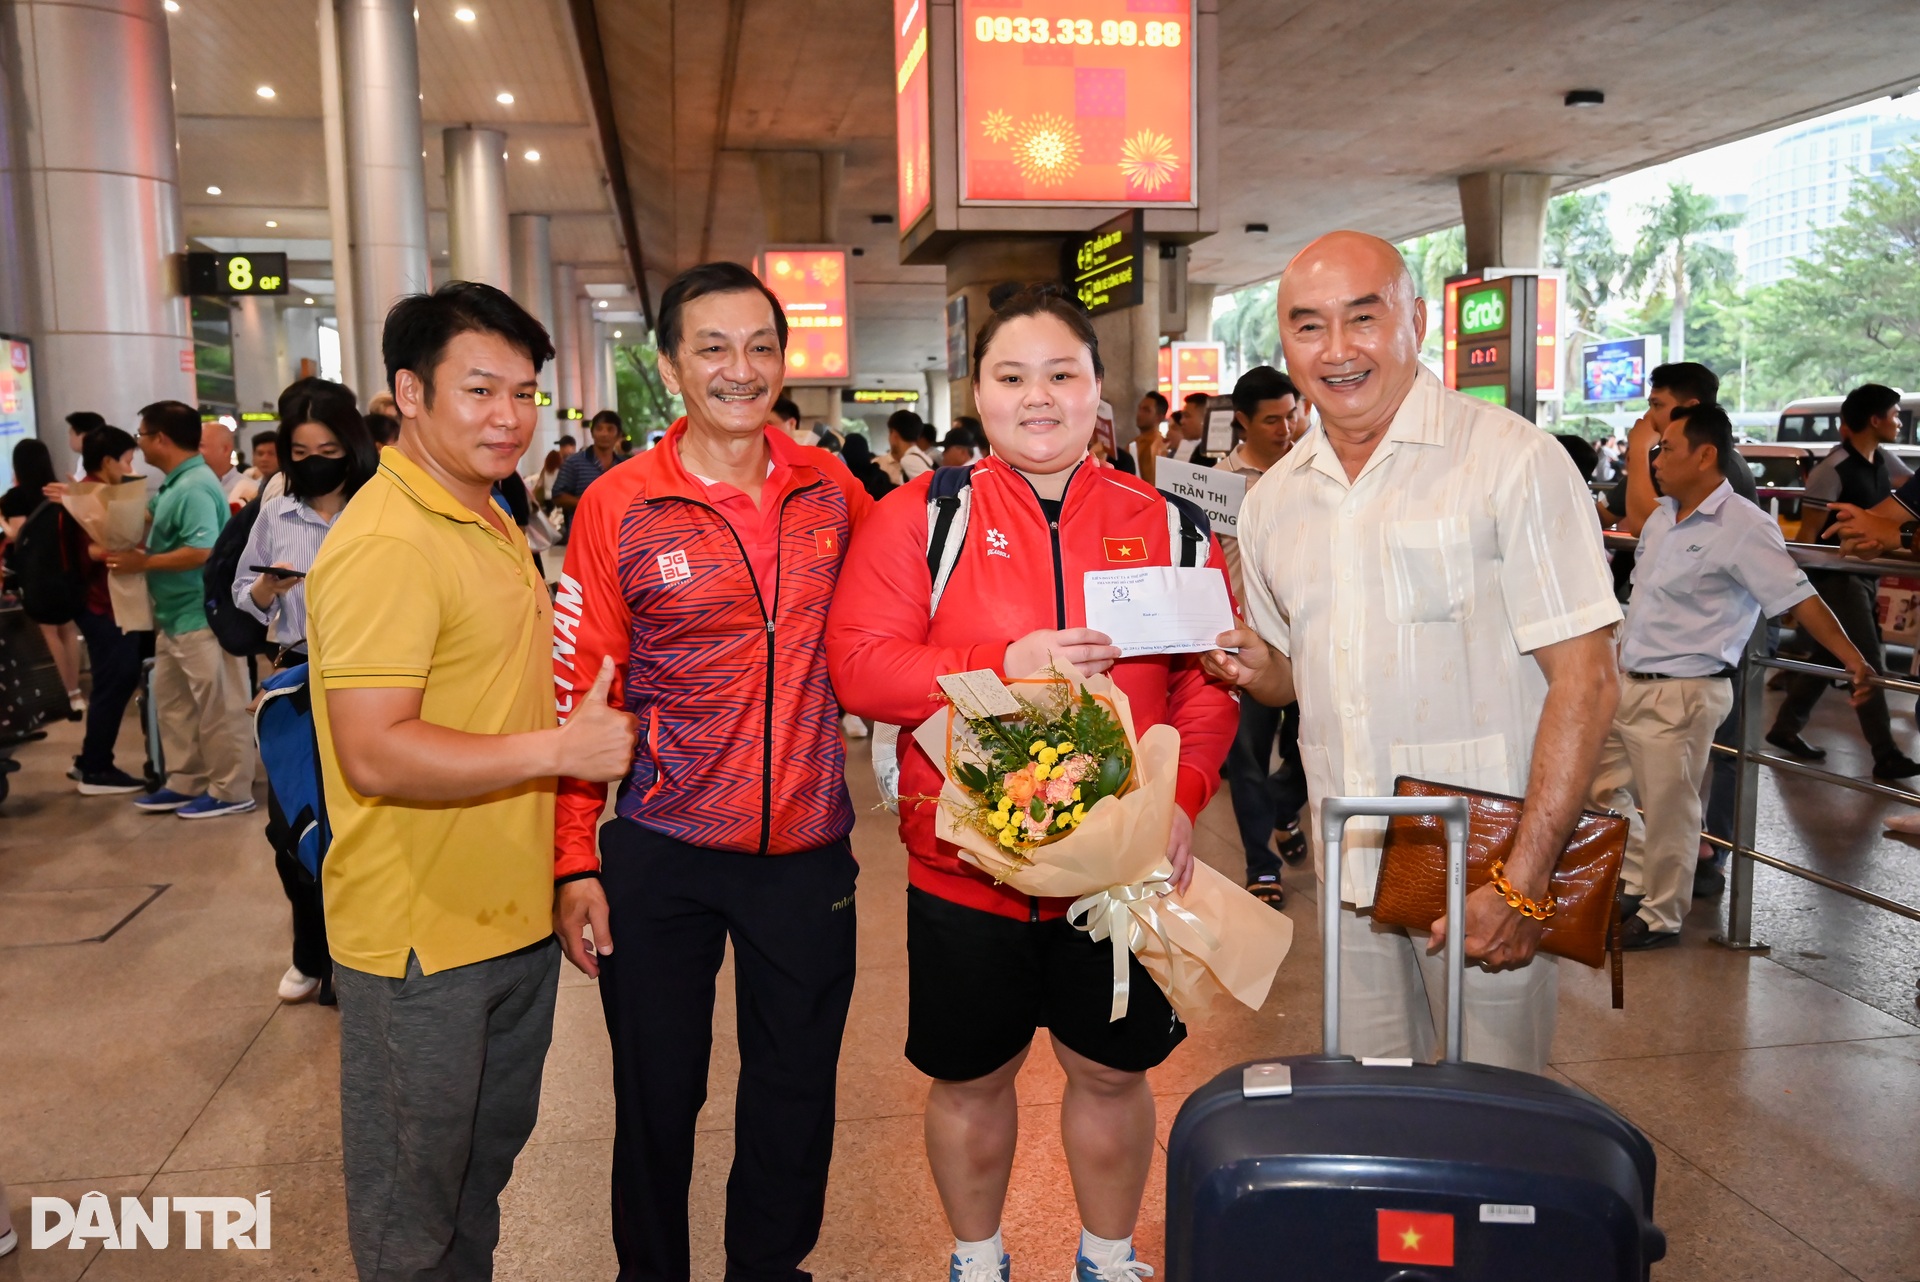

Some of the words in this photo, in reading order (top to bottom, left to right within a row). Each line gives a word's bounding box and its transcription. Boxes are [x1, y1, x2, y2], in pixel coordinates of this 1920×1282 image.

[975, 15, 1182, 48] 0933.33.99.88
[228, 256, 253, 291] 8
[1462, 292, 1505, 330] Grab
[1172, 482, 1205, 499] TRẦN
[1207, 491, 1228, 507] THỊ
[1192, 472, 1208, 484] CHỊ
